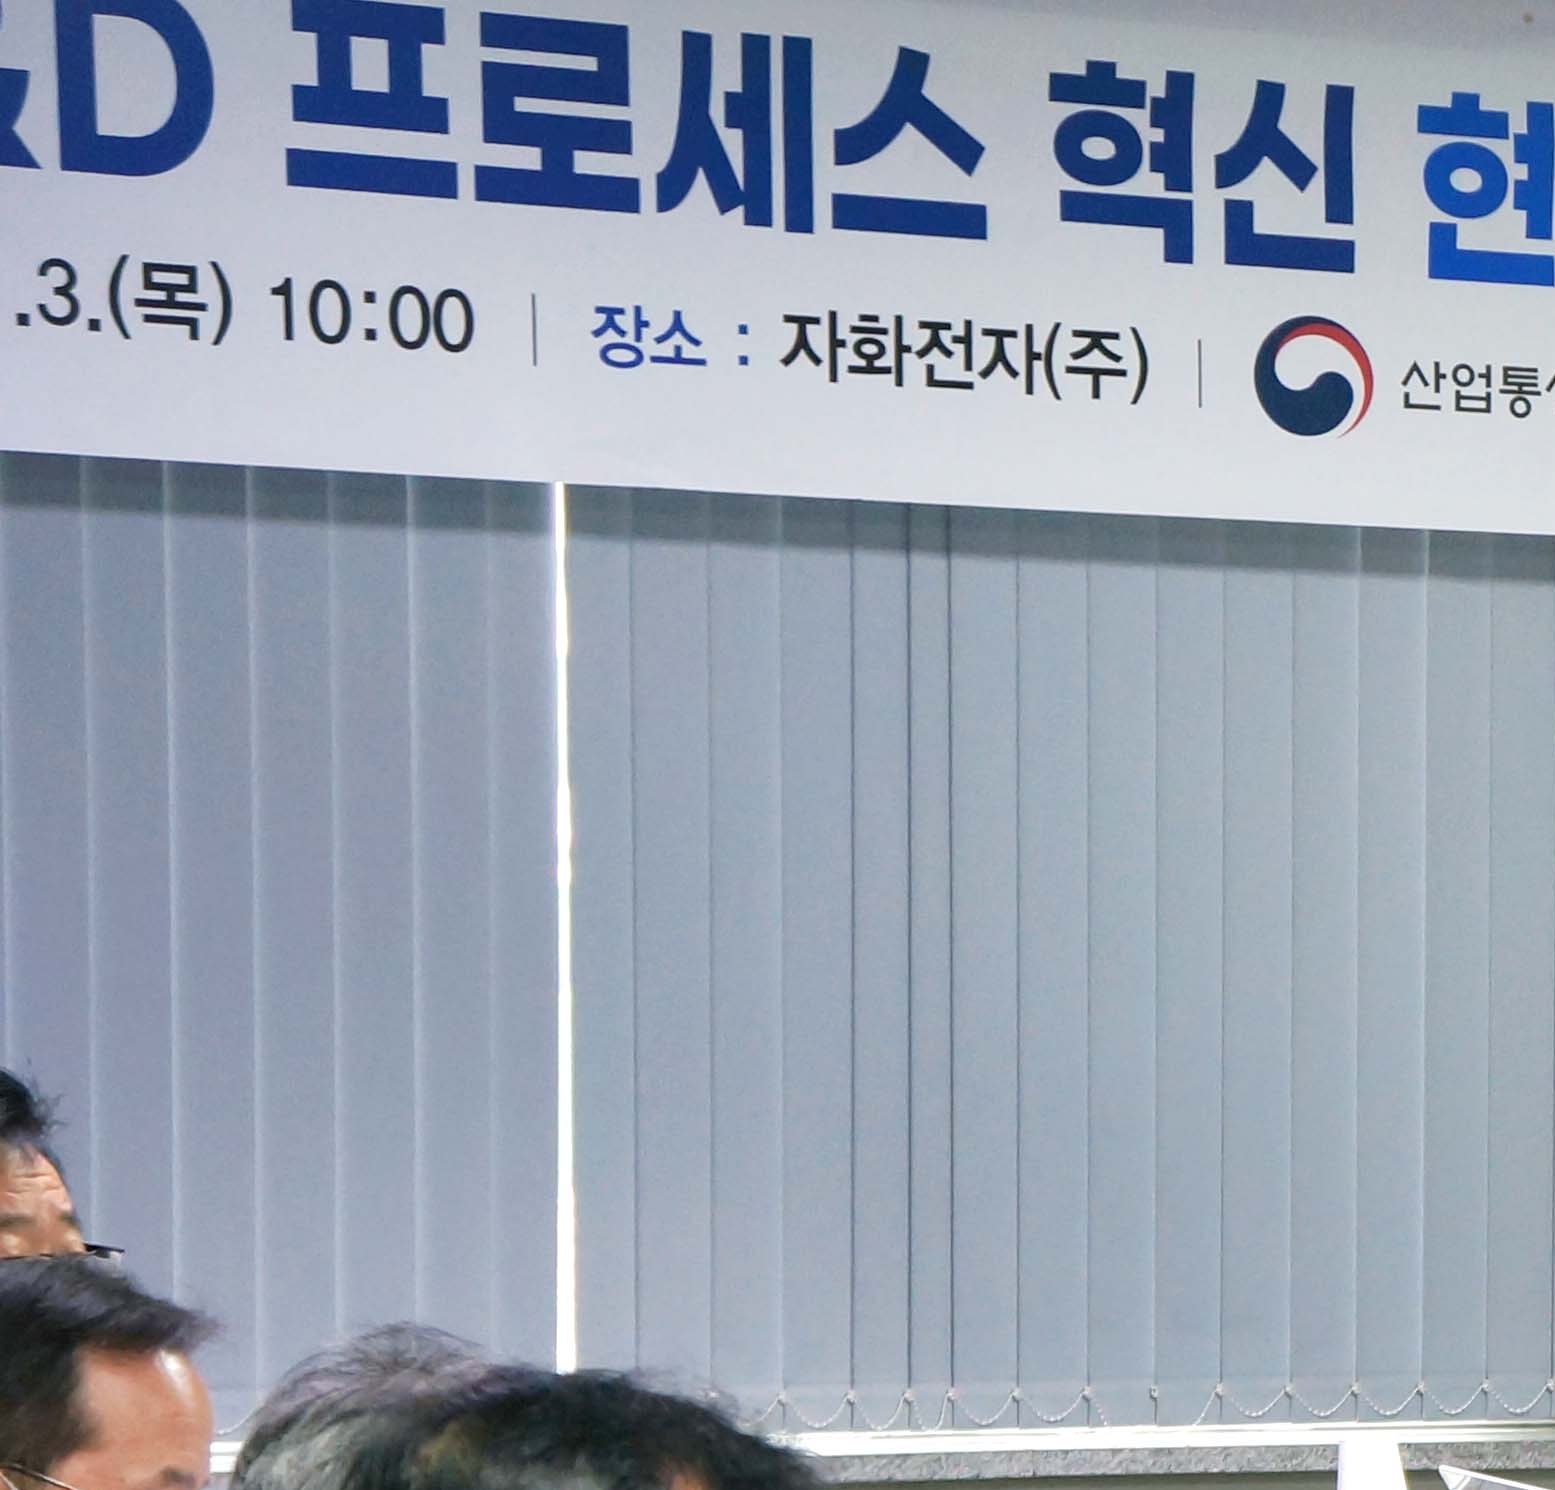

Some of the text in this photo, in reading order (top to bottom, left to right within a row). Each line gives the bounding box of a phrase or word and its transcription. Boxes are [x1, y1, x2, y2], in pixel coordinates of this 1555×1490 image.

[286, 0, 988, 240] 프로세스
[1047, 59, 1356, 275] 혁신
[268, 275, 475, 354] 10:00
[590, 302, 708, 369] 장소
[779, 307, 1150, 405] 자화전자(주)
